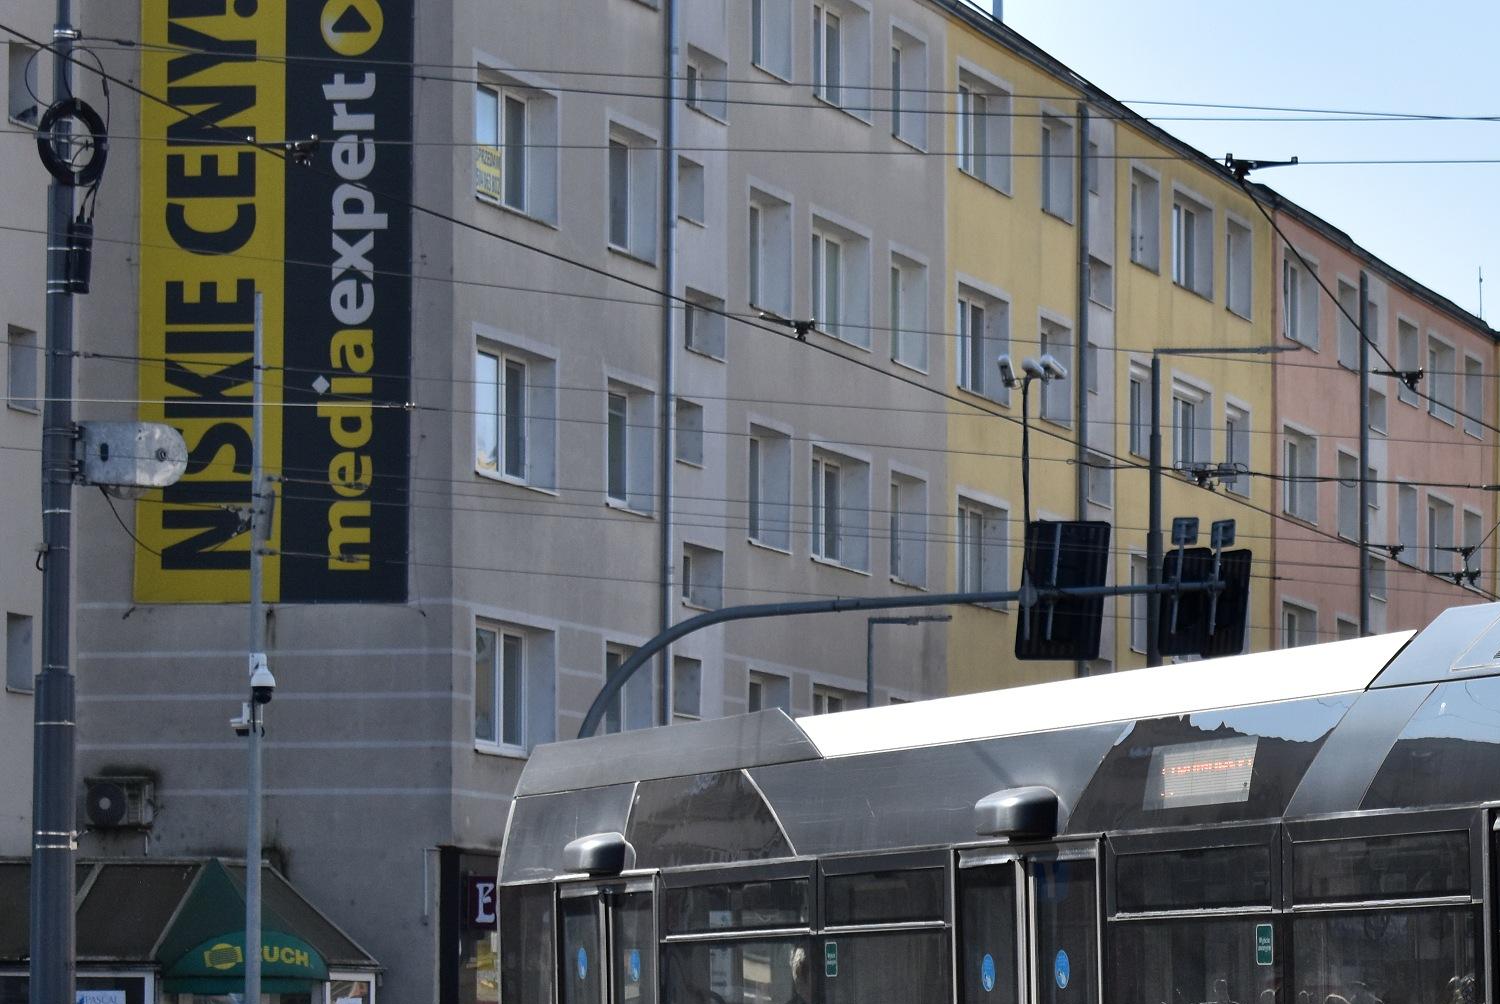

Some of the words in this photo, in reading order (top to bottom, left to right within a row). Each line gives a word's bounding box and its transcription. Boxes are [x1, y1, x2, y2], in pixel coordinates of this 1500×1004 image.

[165, 0, 258, 256] CENY!
[161, 279, 256, 570] NISKIE
[311, 72, 388, 571] mediaexpert
[261, 946, 309, 967] UCH
